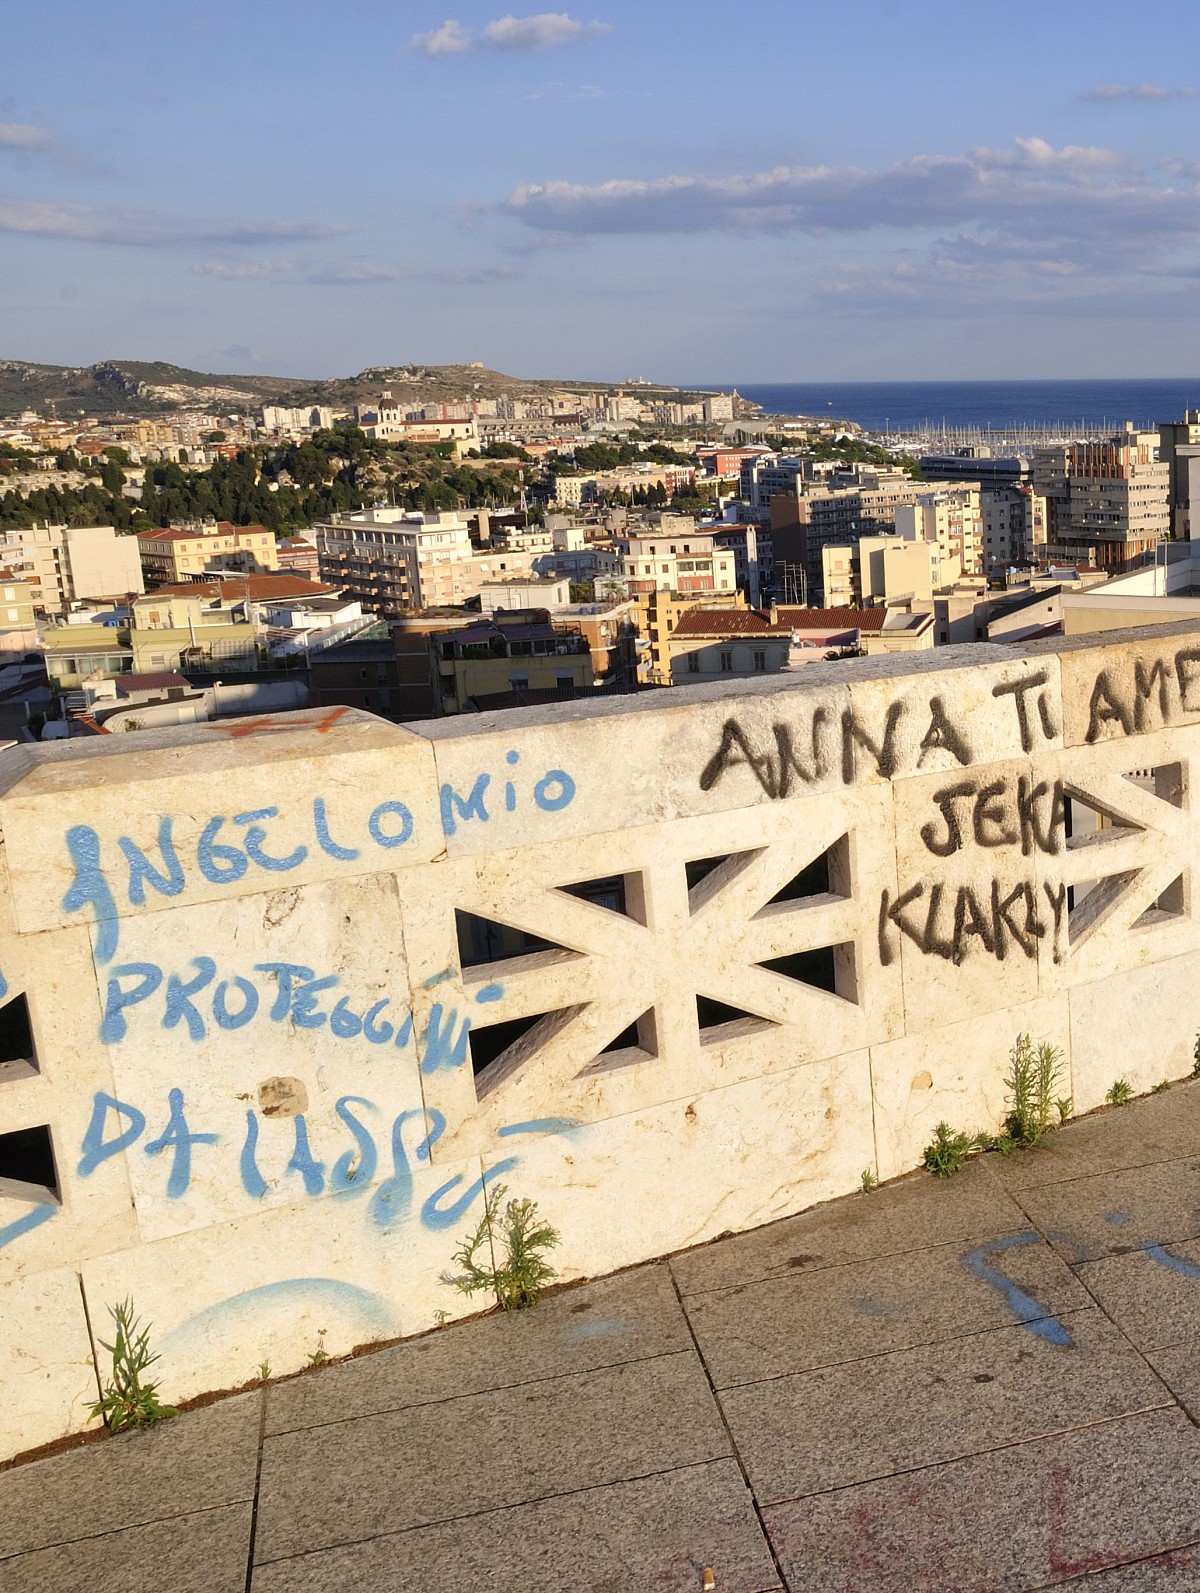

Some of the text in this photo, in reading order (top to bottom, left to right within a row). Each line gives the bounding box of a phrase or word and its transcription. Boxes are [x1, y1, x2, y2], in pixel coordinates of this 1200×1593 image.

[700, 696, 973, 799] ANNA
[993, 669, 1058, 753] TI
[77, 1086, 222, 1199] DA
